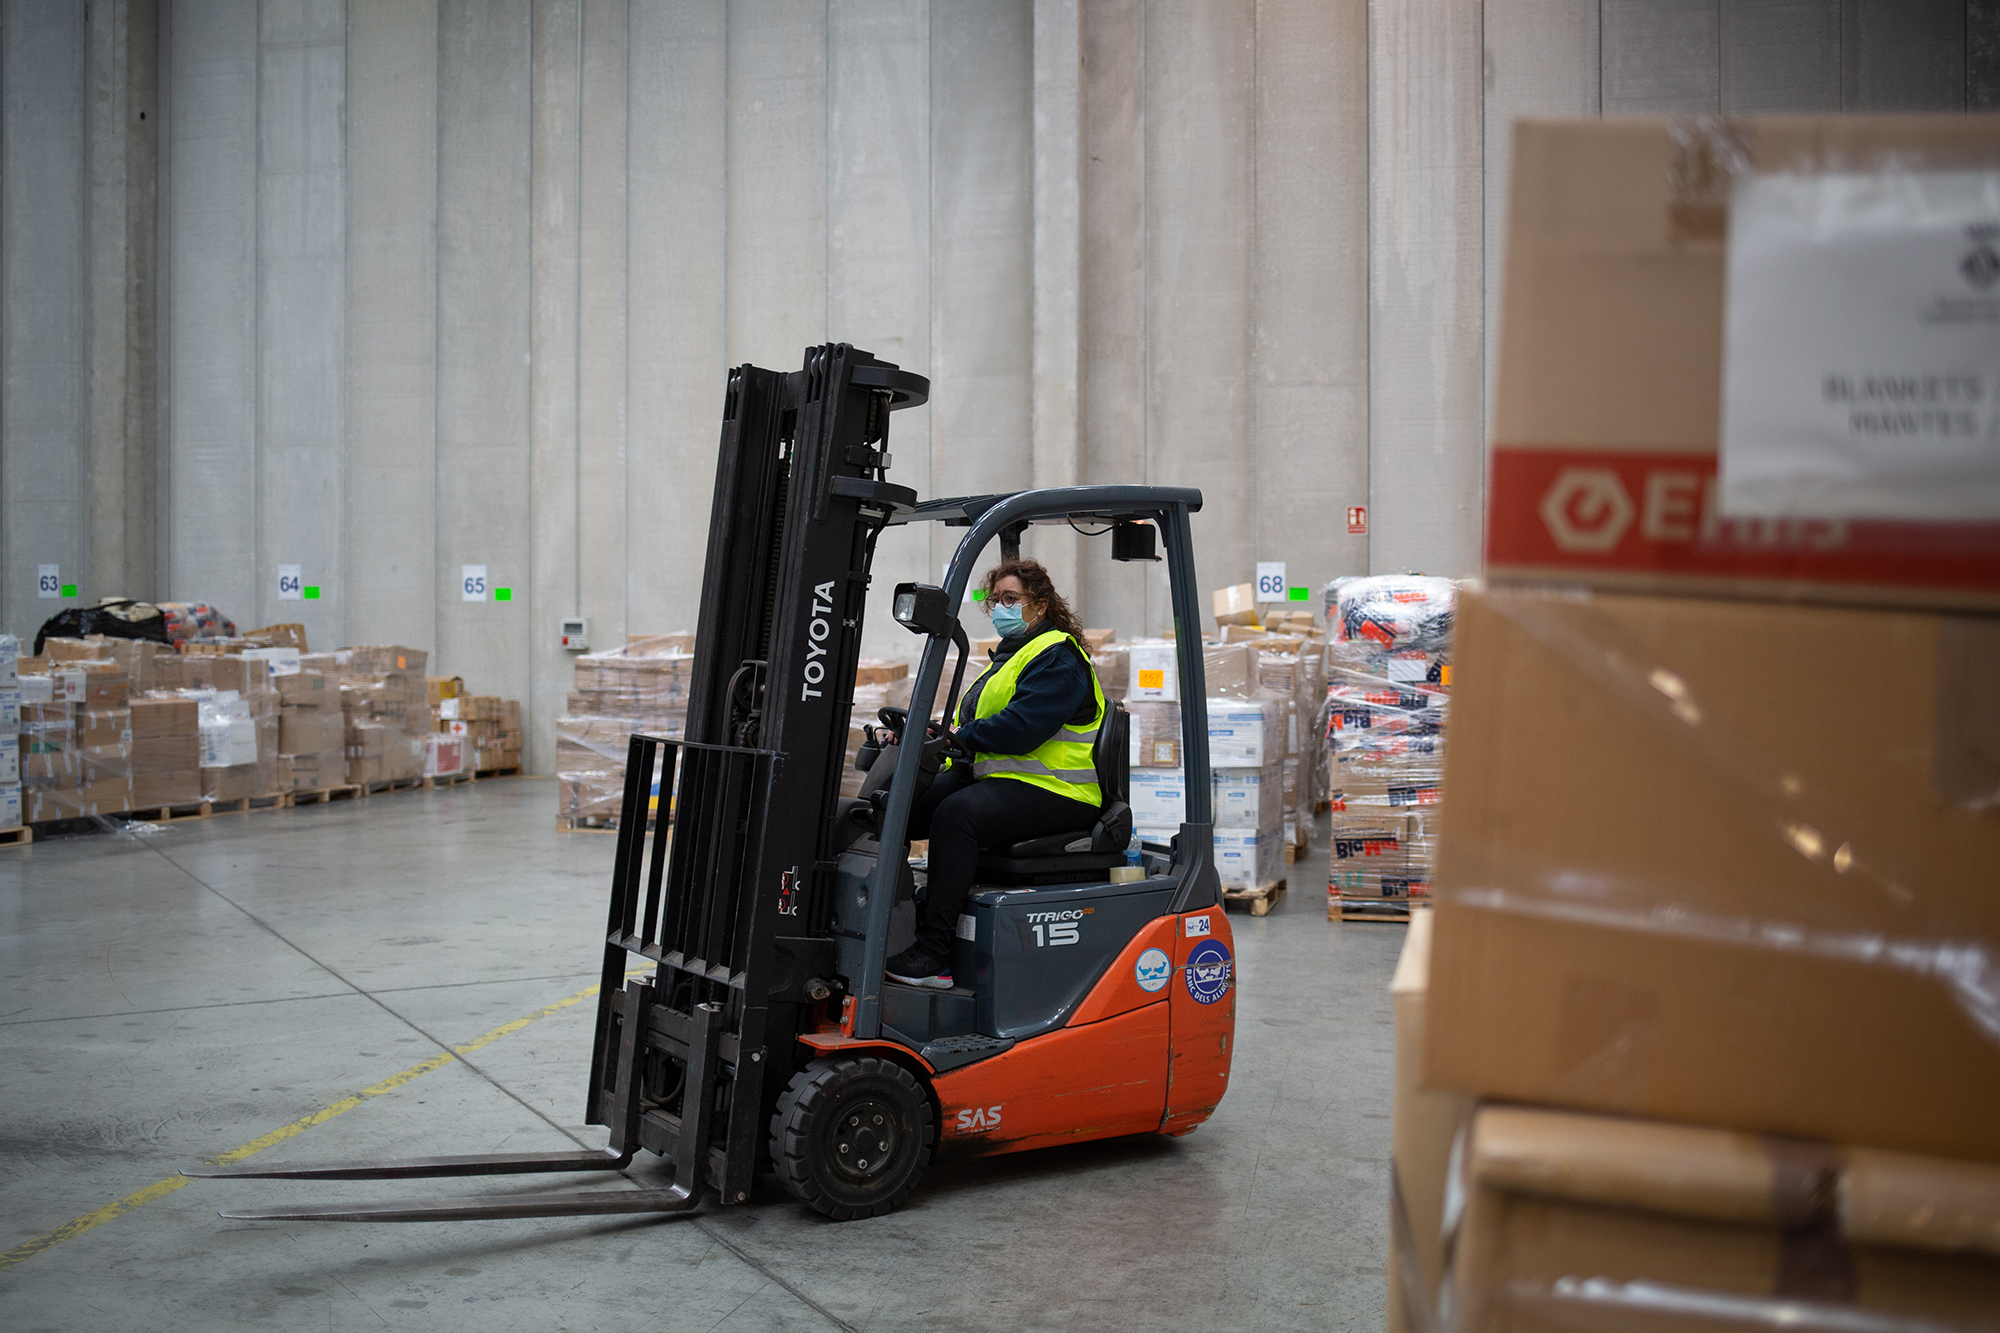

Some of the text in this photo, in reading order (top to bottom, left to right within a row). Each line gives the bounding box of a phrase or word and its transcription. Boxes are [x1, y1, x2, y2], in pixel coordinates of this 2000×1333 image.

[1823, 376, 1983, 403] BLANKETS
[40, 575, 58, 592] 63
[280, 576, 299, 592] 64
[464, 577, 485, 594] 65
[1259, 575, 1283, 593] 68
[801, 580, 835, 702] TOYOTA
[1032, 921, 1080, 947] 15
[1186, 968, 1196, 995] BANC
[1194, 991, 1210, 1003] DELS
[957, 1105, 1002, 1130] SAS
